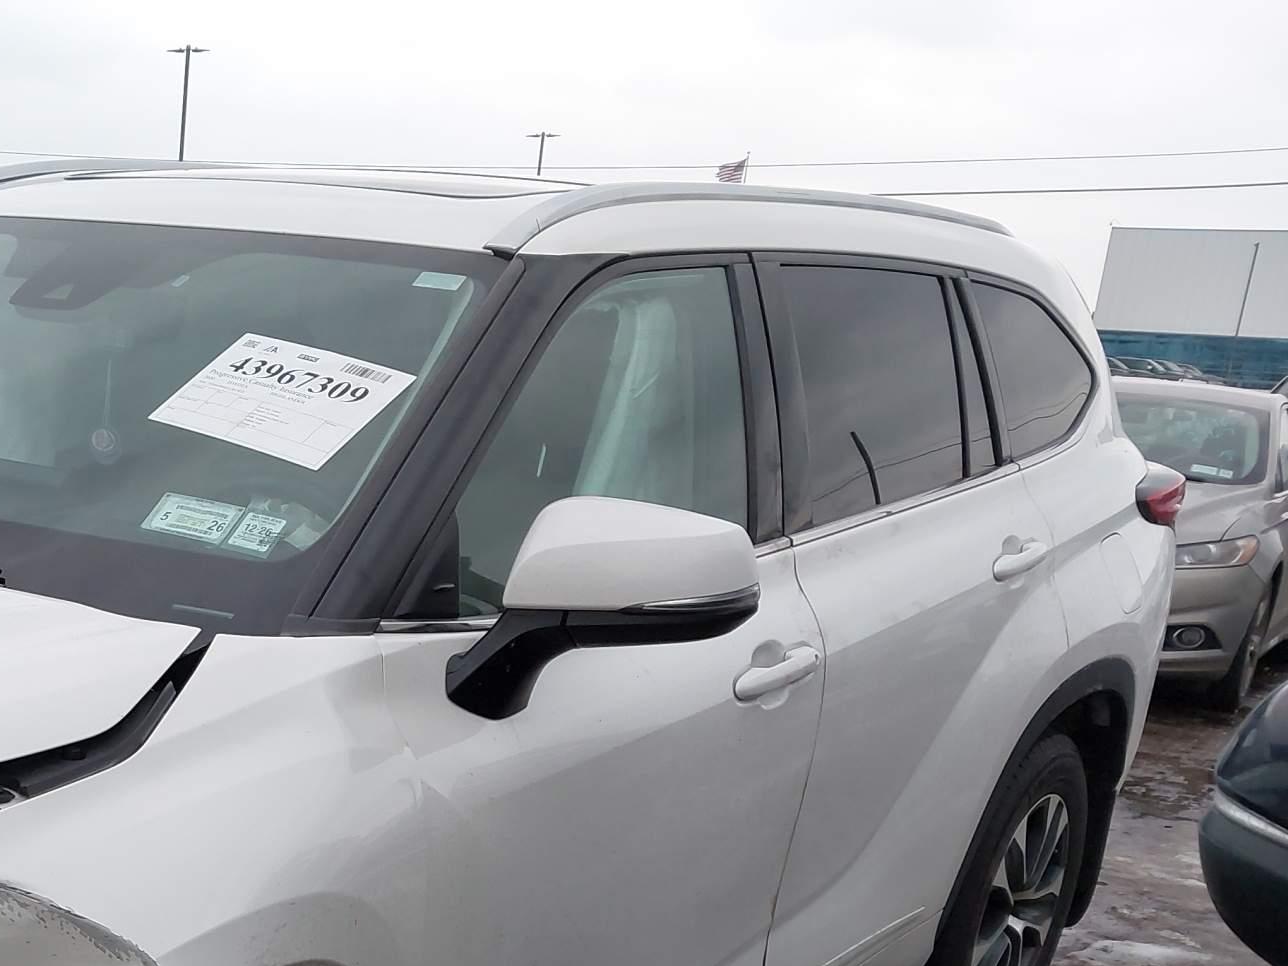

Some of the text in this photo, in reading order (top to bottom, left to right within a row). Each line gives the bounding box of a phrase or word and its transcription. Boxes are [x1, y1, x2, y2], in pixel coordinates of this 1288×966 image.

[229, 357, 370, 403] 43967309
[160, 511, 171, 521] 5
[207, 520, 226, 533] 26
